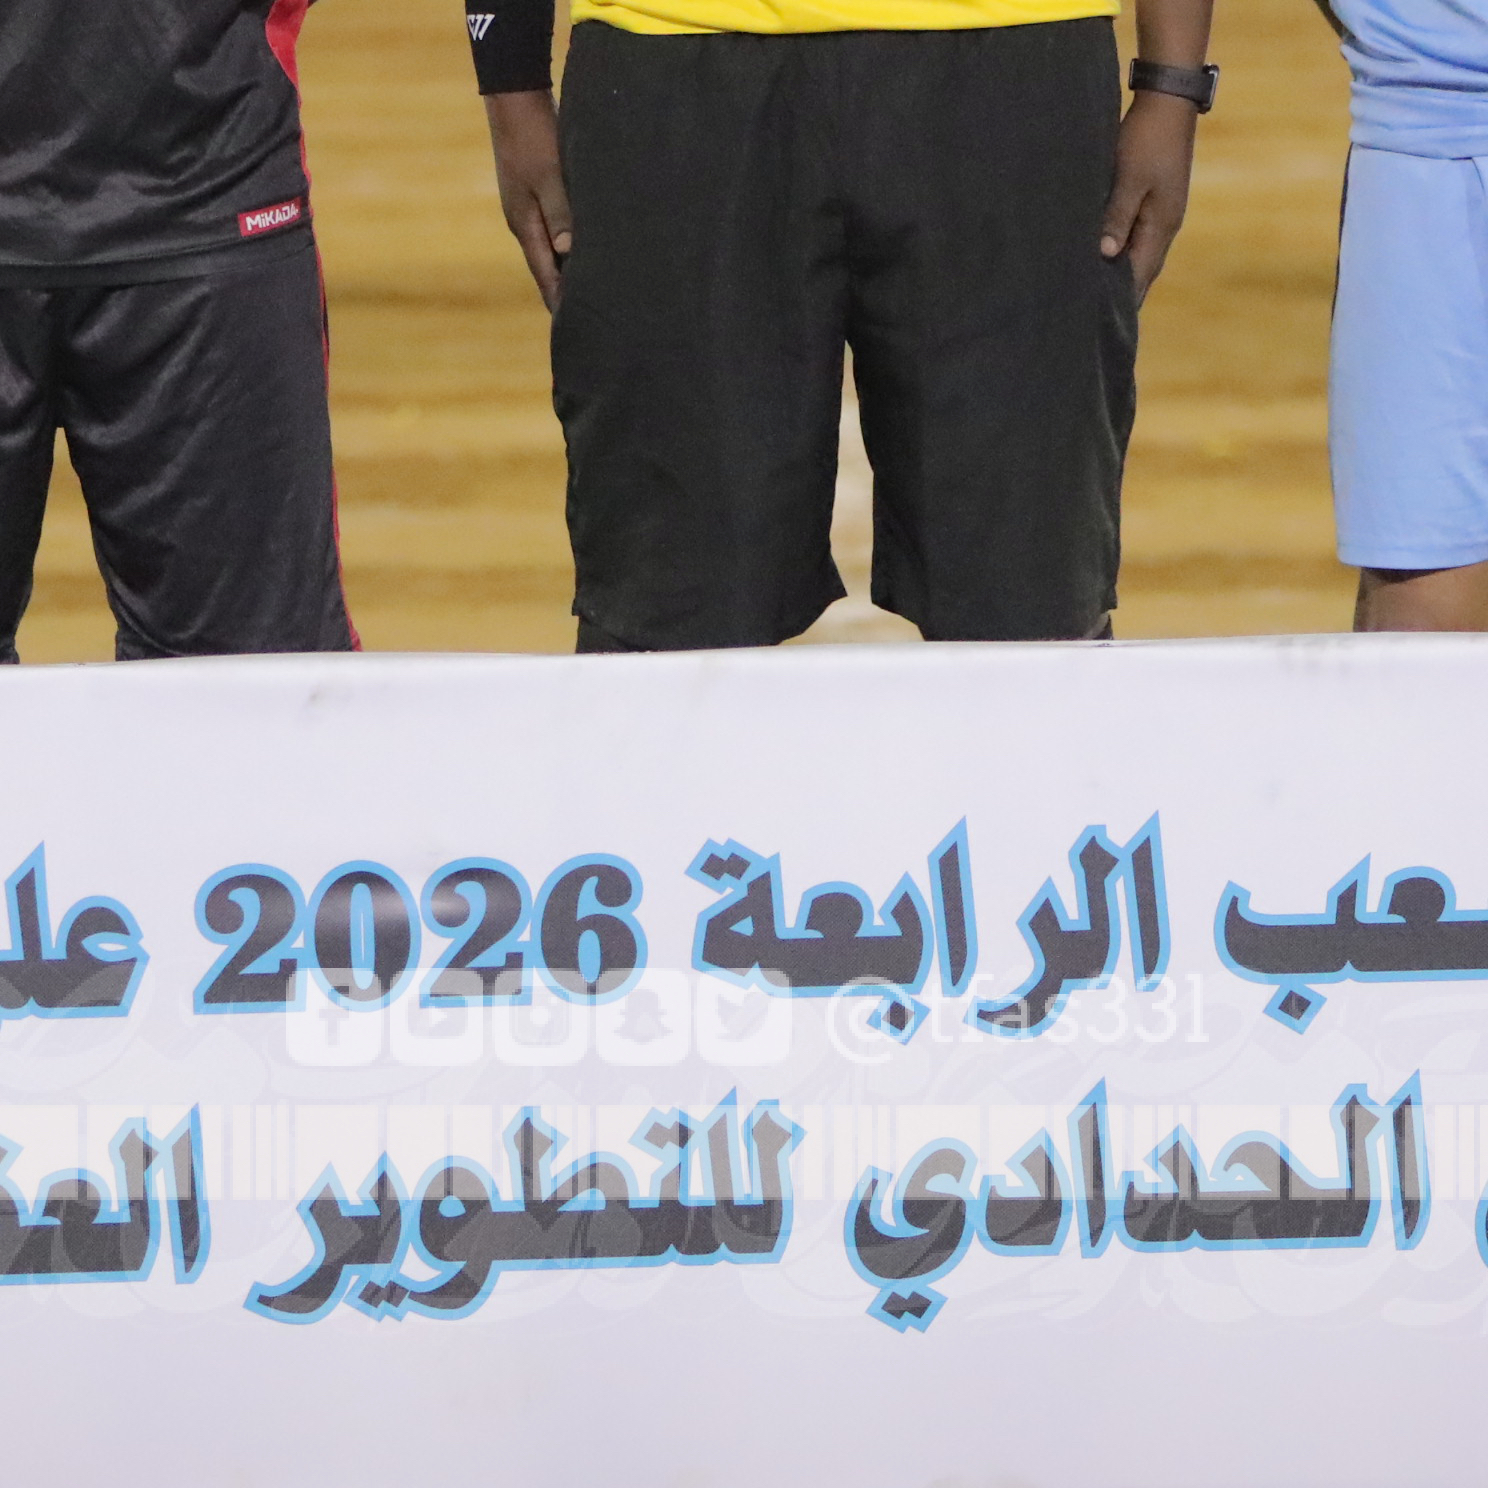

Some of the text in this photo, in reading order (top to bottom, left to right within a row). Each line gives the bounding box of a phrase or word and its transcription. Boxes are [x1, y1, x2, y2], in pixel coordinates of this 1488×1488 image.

[193, 852, 648, 1016] 2026
[684, 809, 1172, 1045] الرابعة
[242, 1085, 808, 1326] للتطوير
[843, 1067, 1432, 1335] الحدادي
